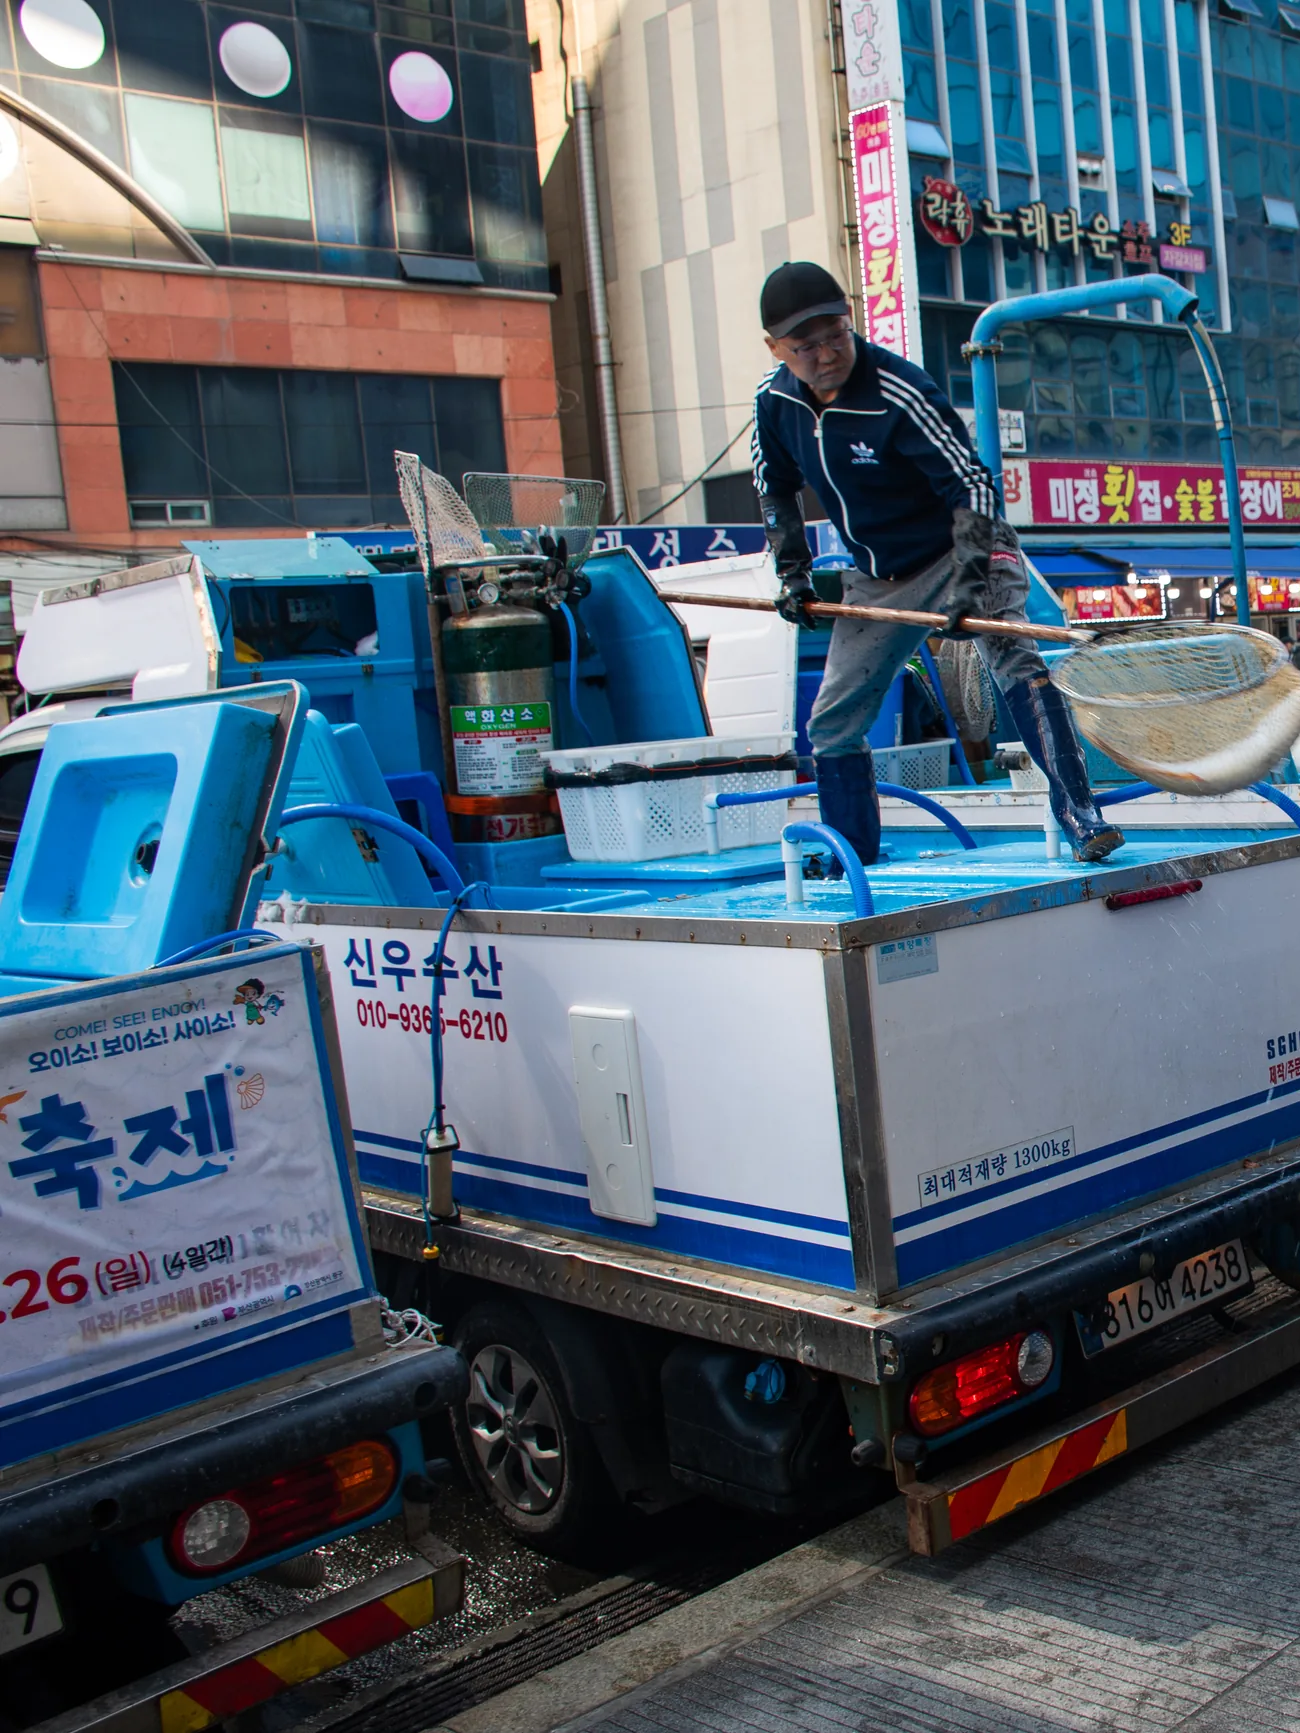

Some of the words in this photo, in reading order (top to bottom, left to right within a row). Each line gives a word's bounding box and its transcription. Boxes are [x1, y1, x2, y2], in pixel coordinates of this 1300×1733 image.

[981, 199, 1117, 260] 노래타운
[1170, 221, 1192, 247] 3F
[344, 938, 503, 999] 신우수산
[28, 1041, 99, 1073] 오이소!
[102, 1026, 169, 1058] 보이소!
[173, 1010, 236, 1042] 사이소!
[54, 1019, 108, 1041] COME!
[113, 1011, 146, 1030] SEE!
[152, 998, 206, 1021] ENJOY!
[8, 1073, 237, 1210] 축제
[923, 1153, 1007, 1198] 최대적재량
[1014, 1138, 1070, 1169] 1300kg
[162, 1235, 234, 1280] (4일간)
[1182, 1245, 1242, 1302] 4238
